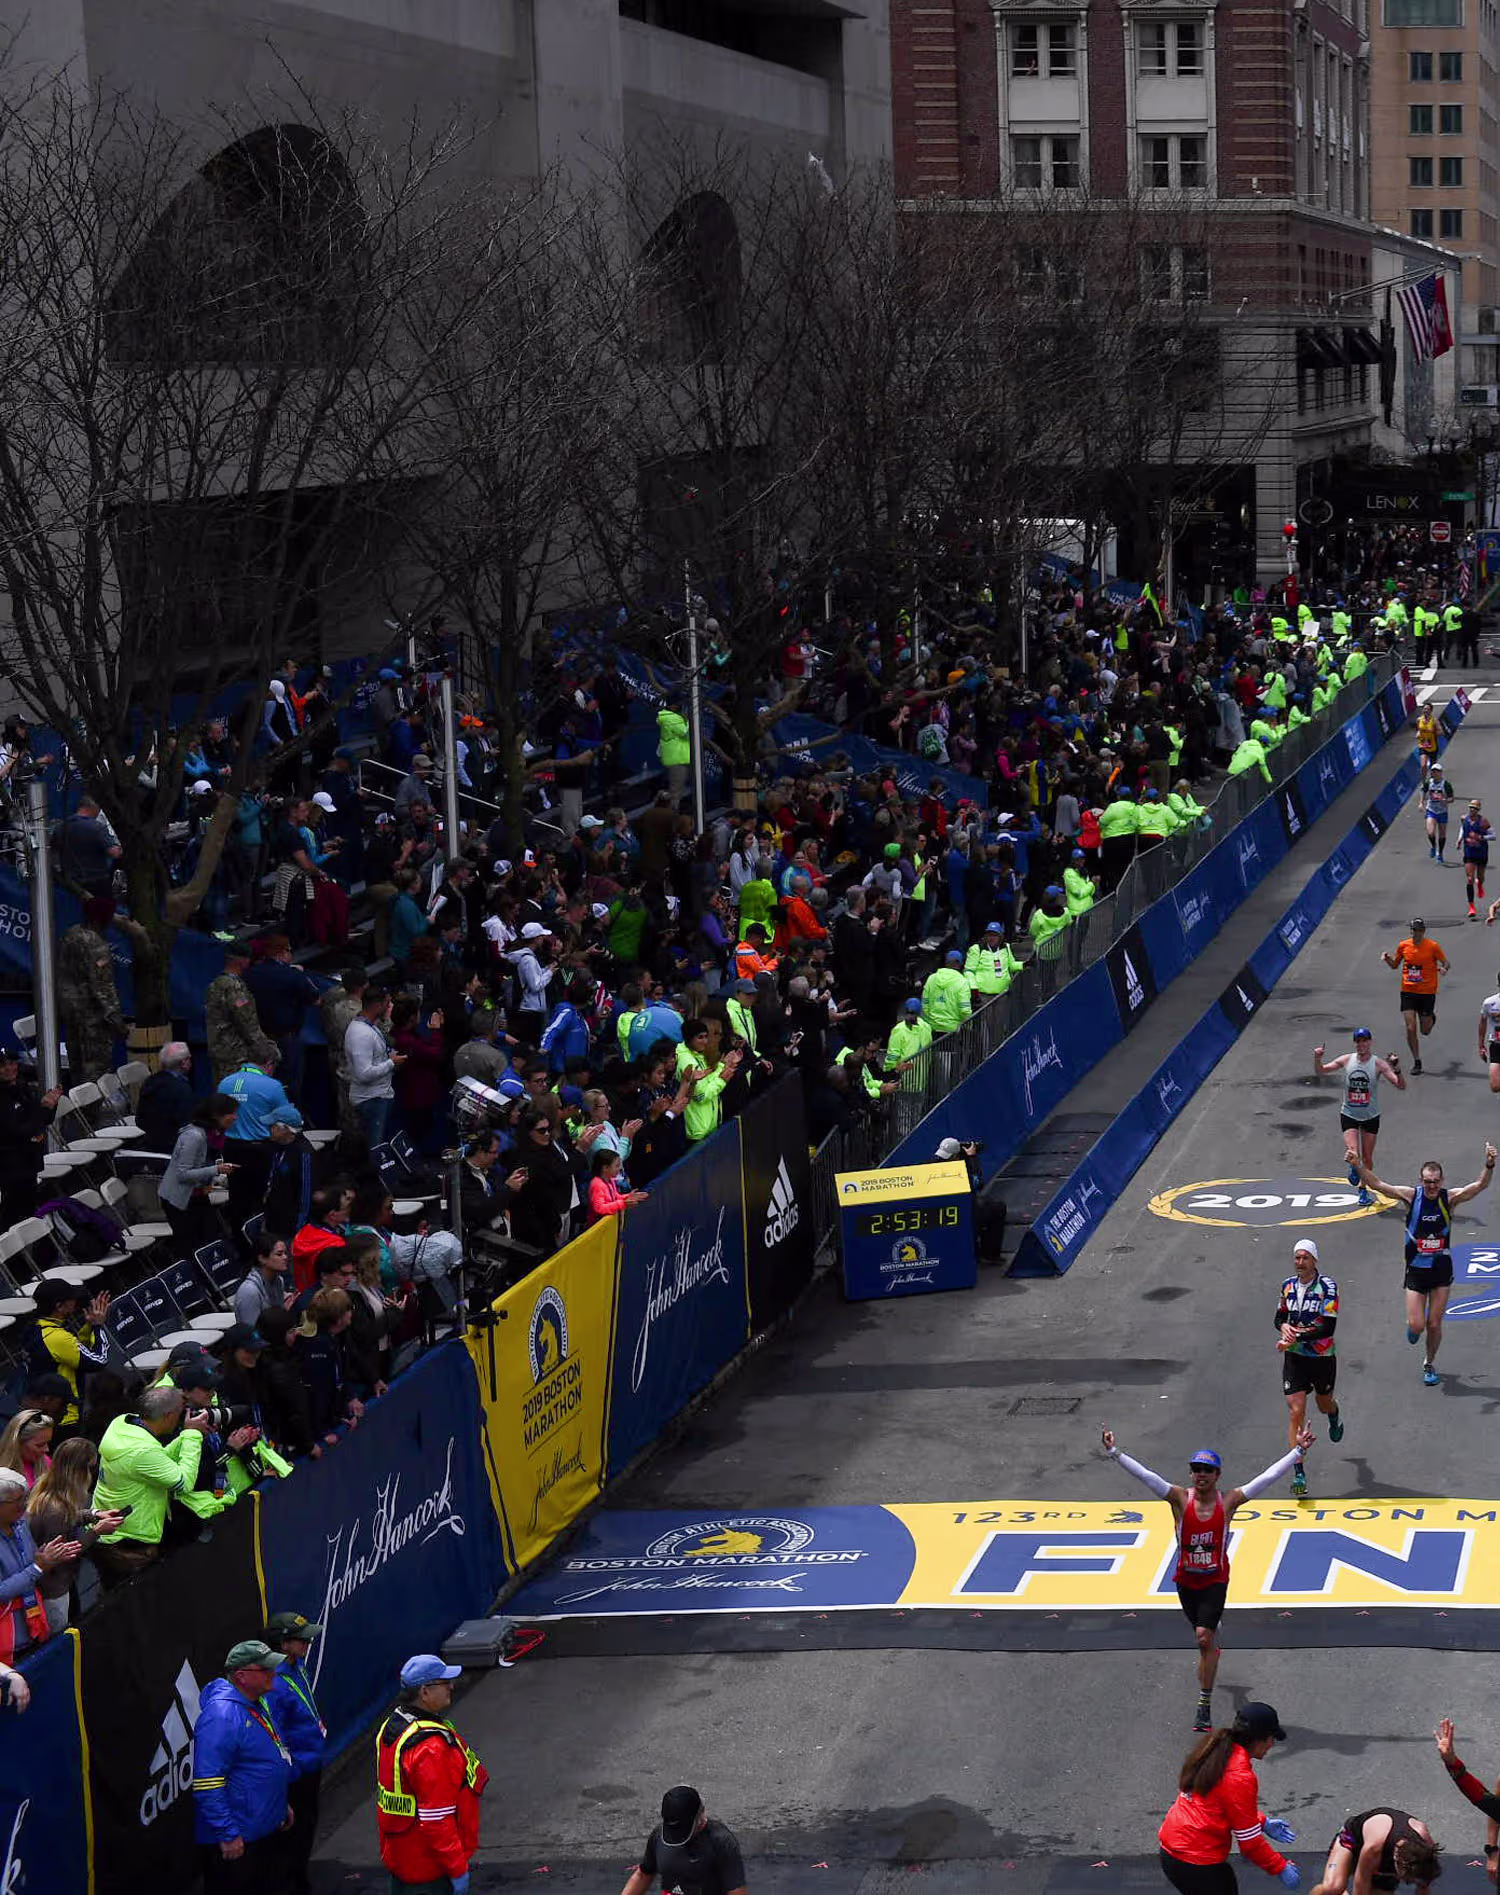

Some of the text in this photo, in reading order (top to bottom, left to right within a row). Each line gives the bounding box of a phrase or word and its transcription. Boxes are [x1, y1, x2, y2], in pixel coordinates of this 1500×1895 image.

[861, 1182, 914, 1192] MARATHON
[879, 1175, 913, 1185] BOSTON
[1188, 1193, 1361, 1209] 2019
[764, 1202, 799, 1249] adidas
[870, 1206, 959, 1234] 2:53:19
[632, 1205, 730, 1394] John Hancock
[522, 1360, 581, 1424] 2019 BOSTON
[523, 1388, 584, 1450] MARATHON
[366, 1436, 466, 1576] Hancock
[953, 1509, 1087, 1524] 123RD
[1231, 1508, 1425, 1522] OSTON
[565, 1551, 862, 1571] BOSTON MARATHON
[553, 1573, 808, 1605] John Hancock
[140, 1739, 195, 1828] adid
